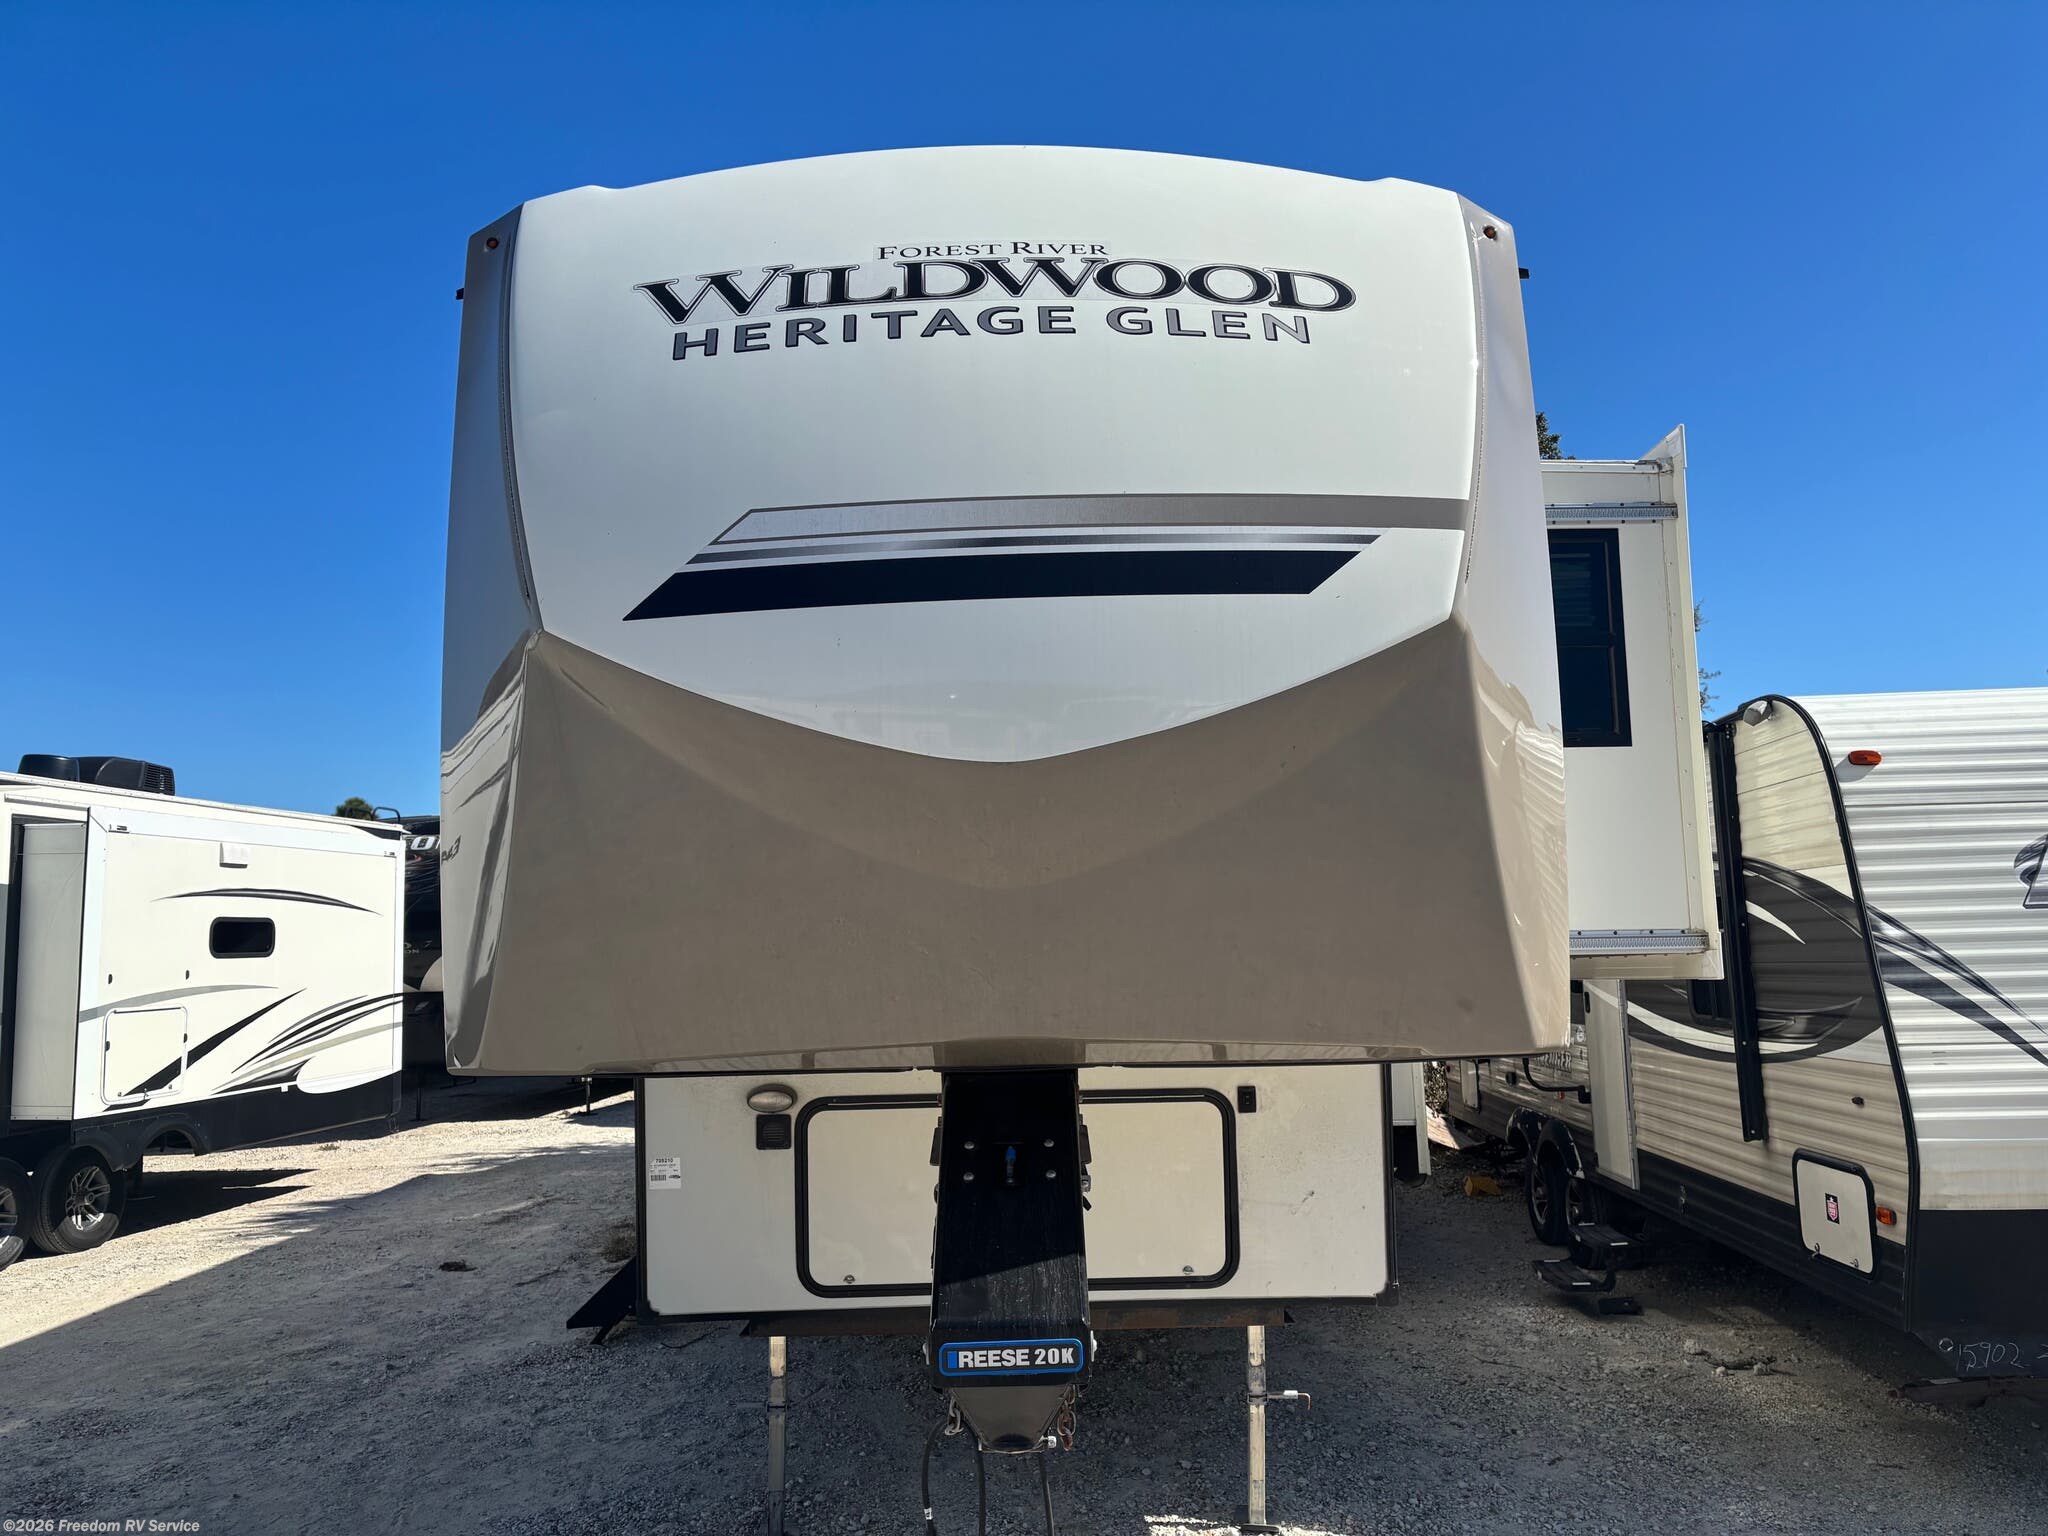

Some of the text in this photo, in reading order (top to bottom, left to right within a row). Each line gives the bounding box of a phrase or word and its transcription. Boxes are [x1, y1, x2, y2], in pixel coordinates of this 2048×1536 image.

[877, 241, 1109, 260] FOREST RIVER
[633, 257, 1357, 325] WILDWOOD
[672, 305, 1312, 361] HERITAGE GLEN
[958, 1347, 1075, 1369] REESE 20K
